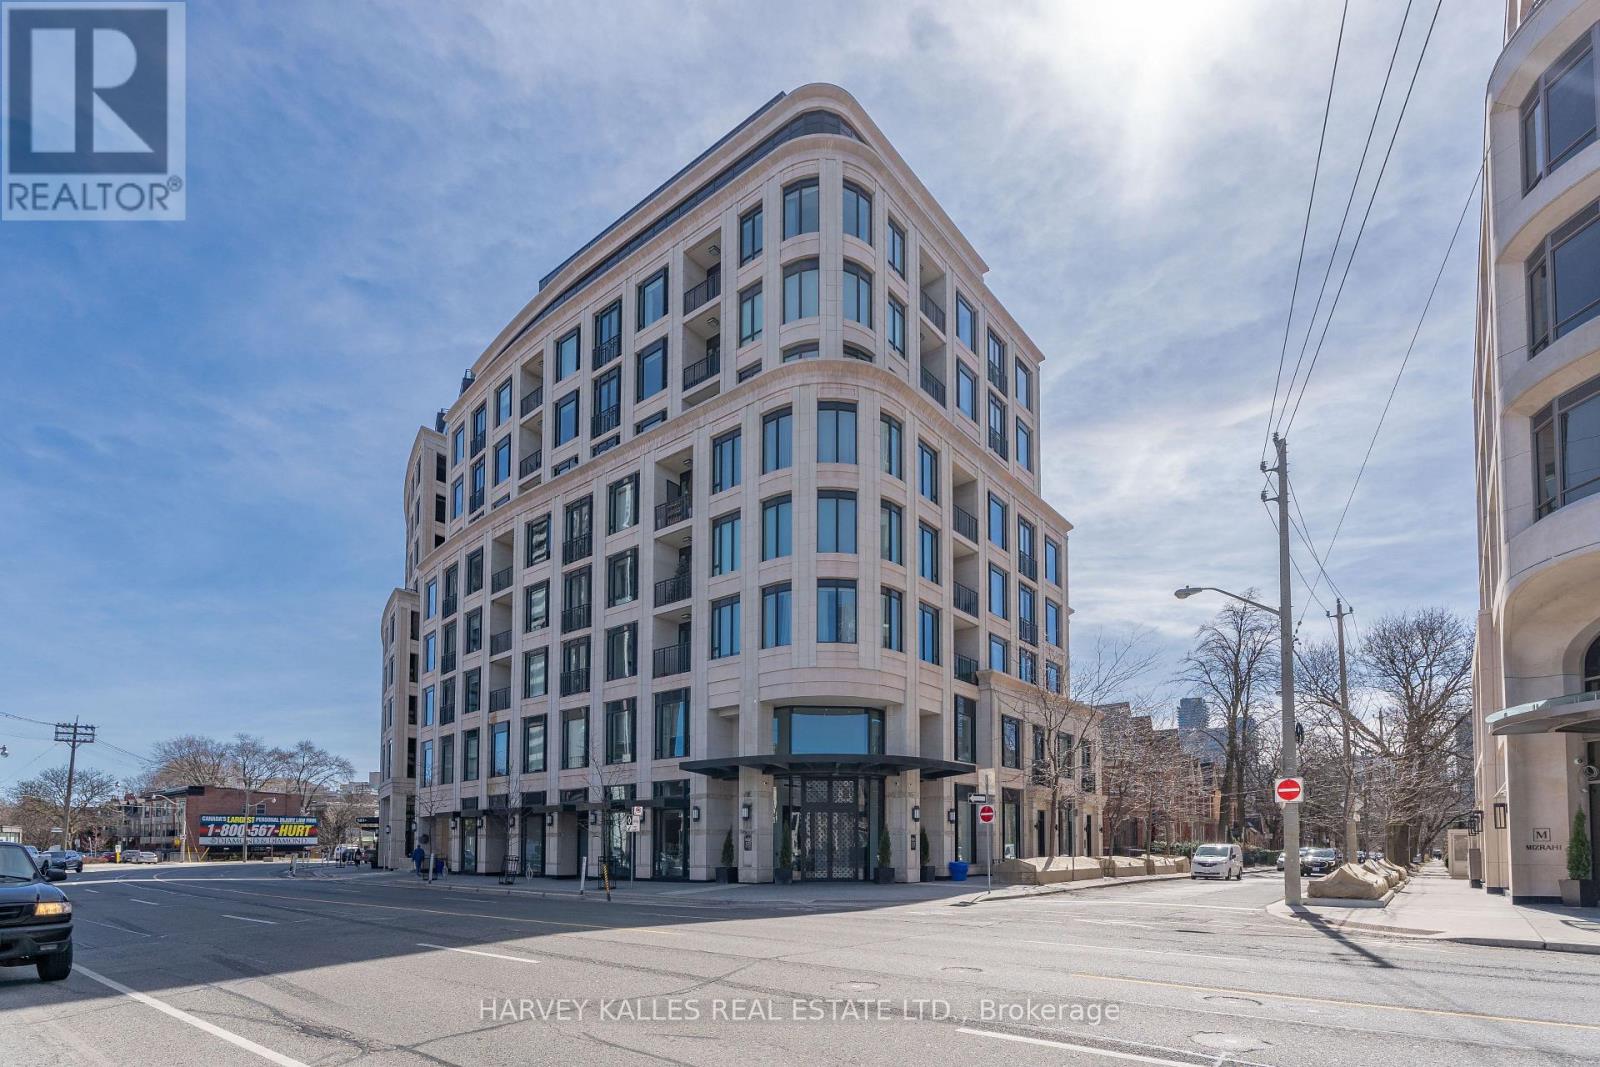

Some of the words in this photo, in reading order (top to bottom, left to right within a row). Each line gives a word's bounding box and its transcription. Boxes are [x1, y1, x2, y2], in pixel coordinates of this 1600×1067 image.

[227, 816, 256, 824] LARGST
[207, 824, 313, 837] 1-800-567-HURT
[1536, 831, 1547, 839] M
